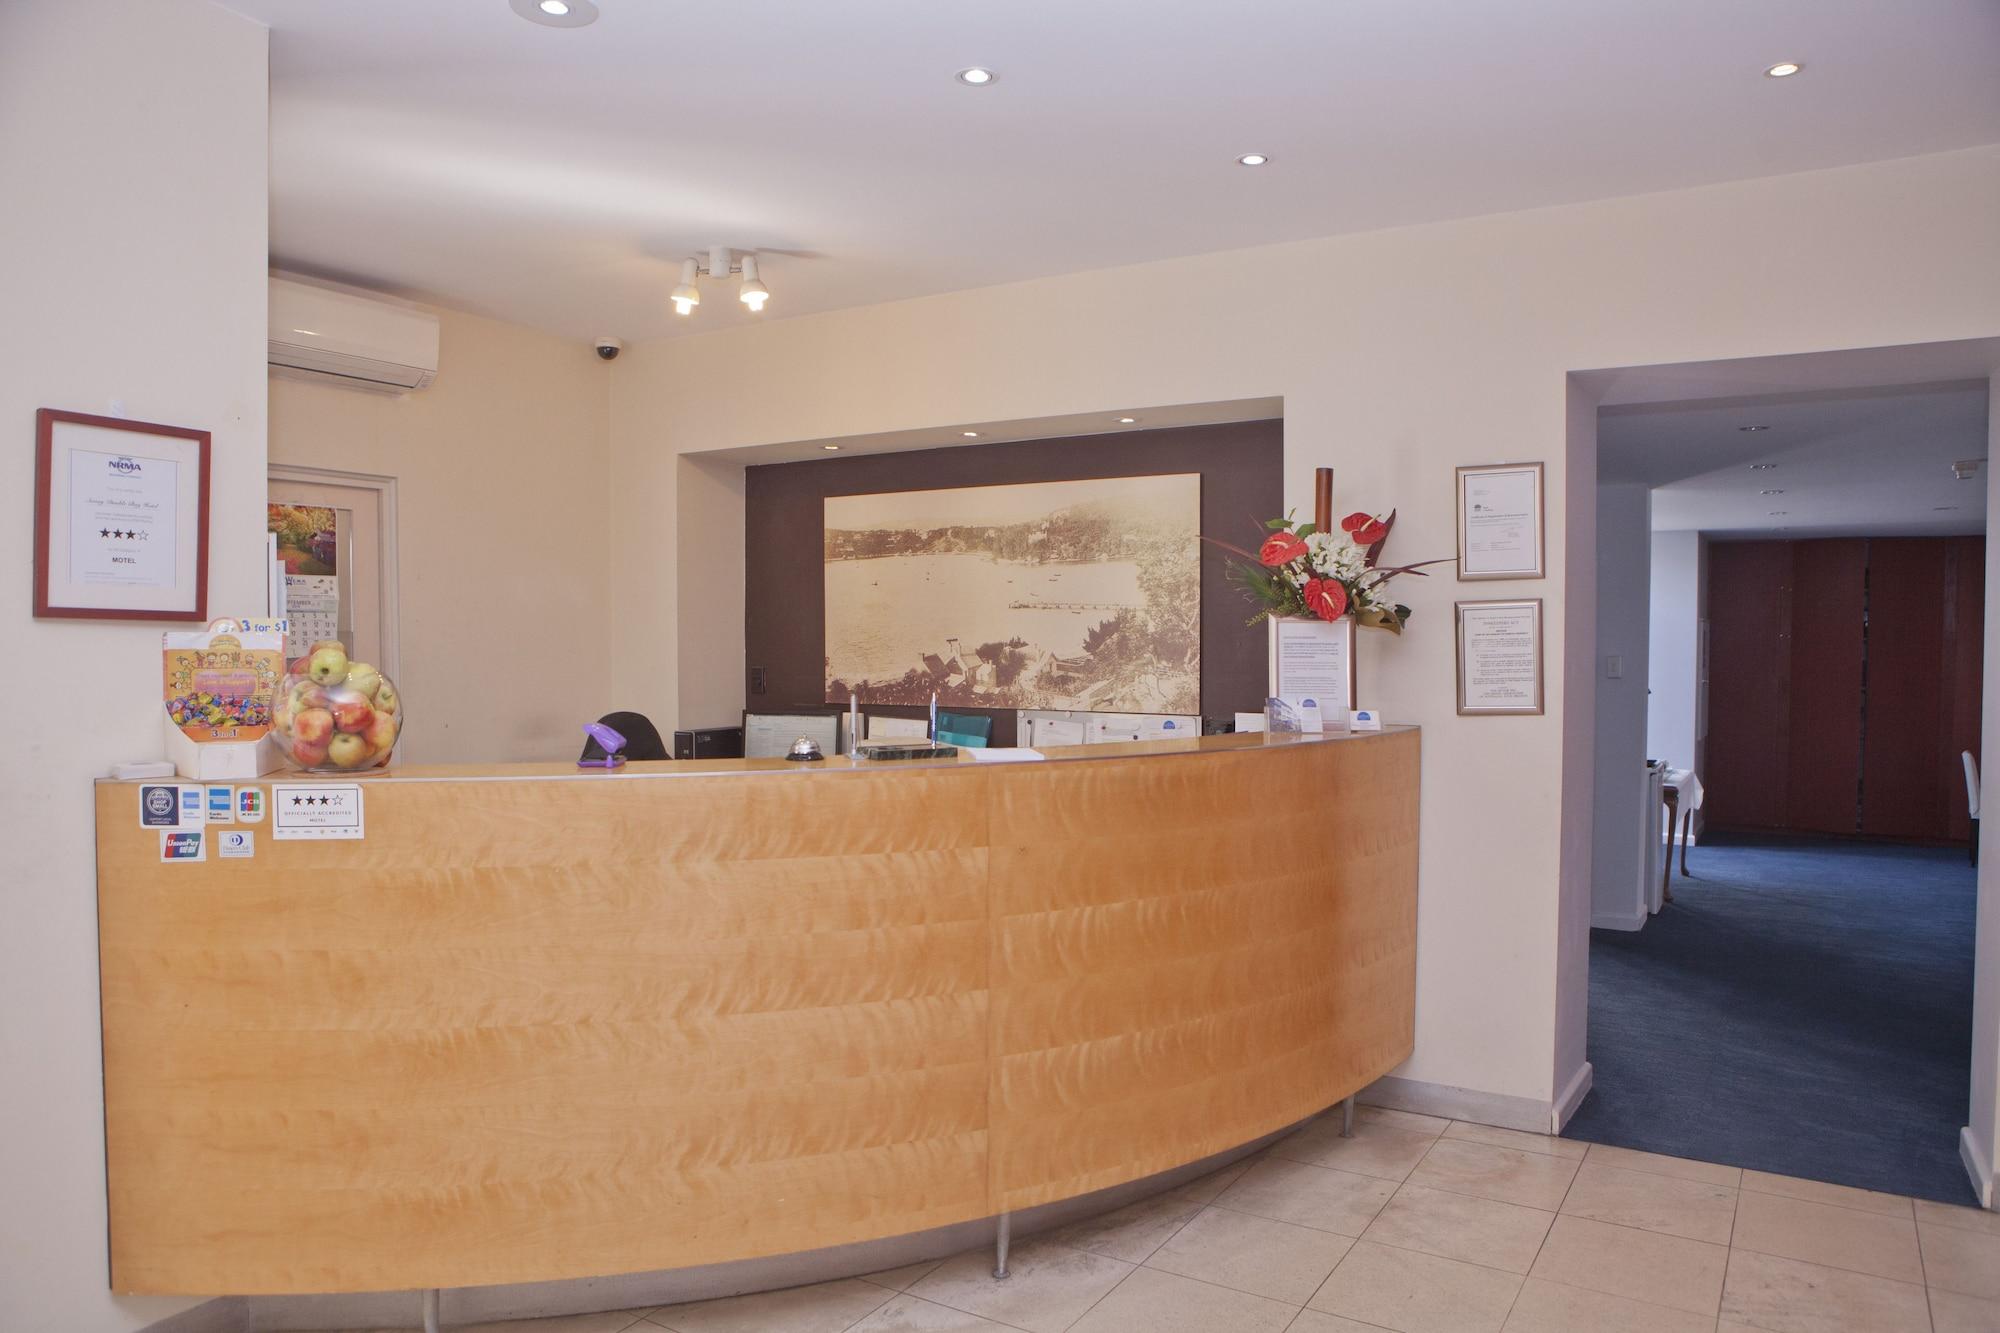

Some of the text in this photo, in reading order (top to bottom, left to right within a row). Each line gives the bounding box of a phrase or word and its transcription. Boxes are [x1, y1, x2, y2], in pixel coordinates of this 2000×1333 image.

[108, 460, 142, 471] NRMA
[241, 619, 287, 632] 3 for $1
[167, 839, 200, 848] UnionPay
